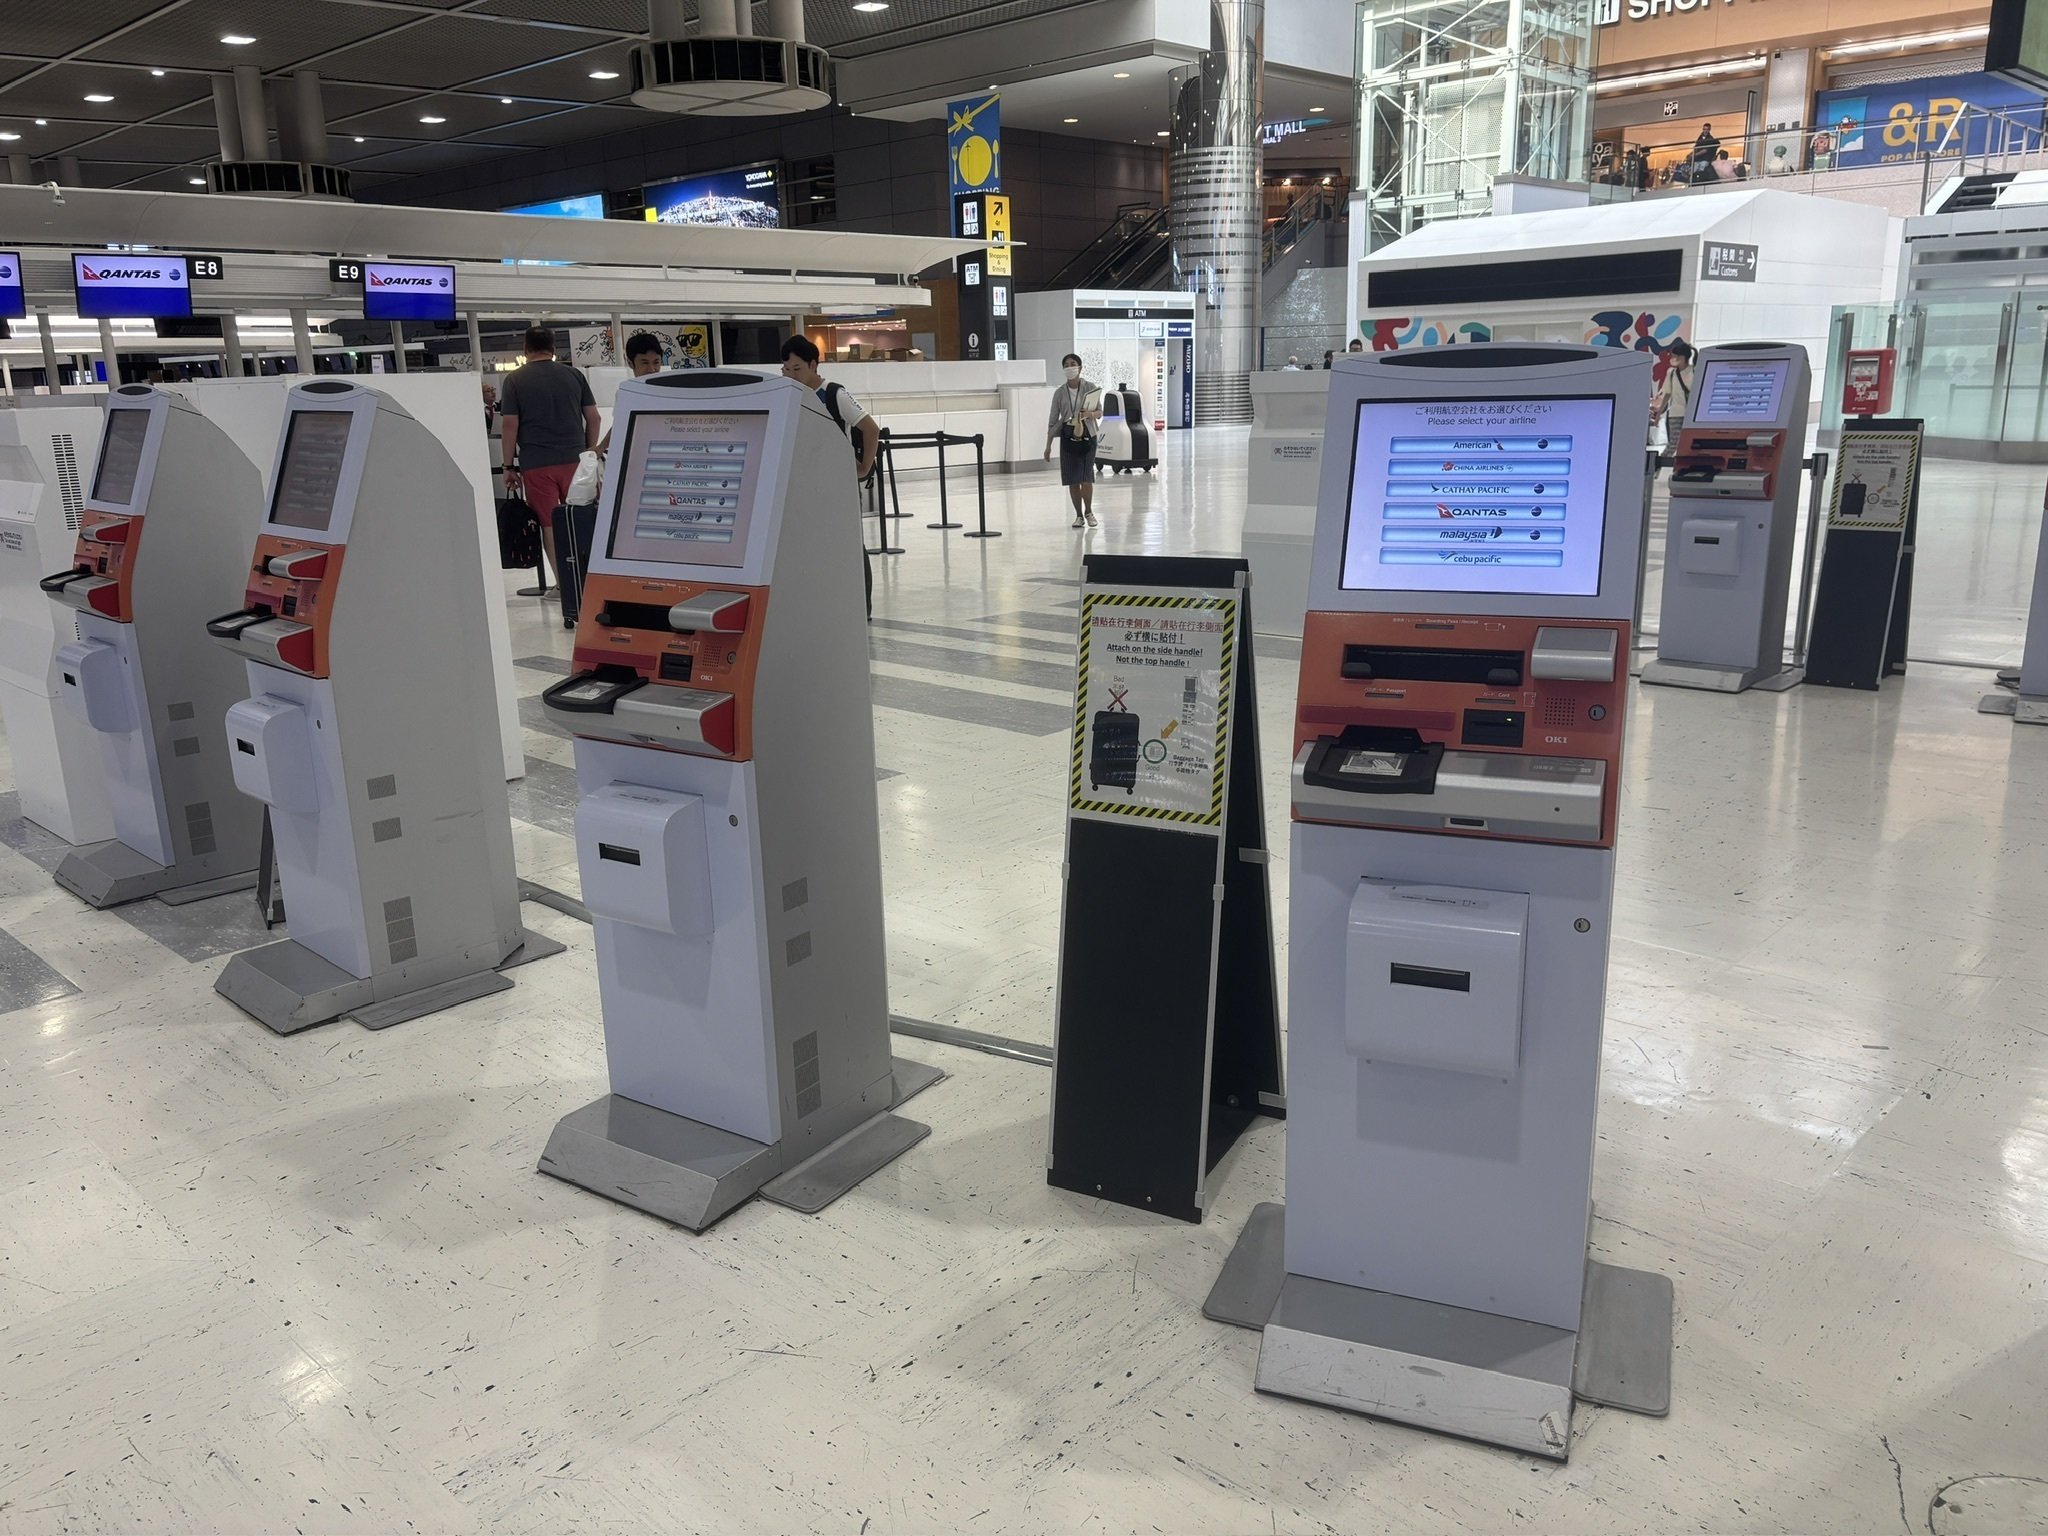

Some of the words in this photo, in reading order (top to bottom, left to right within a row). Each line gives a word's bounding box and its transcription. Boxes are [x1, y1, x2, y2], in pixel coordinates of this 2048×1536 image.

[1274, 120, 1306, 137] MALL
[1880, 153, 1903, 163] POP
[989, 252, 1009, 261] Shopping
[195, 260, 218, 276] E8
[338, 265, 359, 279] E9
[966, 265, 979, 273] ATM
[992, 265, 1006, 274] Dining
[1720, 265, 1739, 277] Customs
[99, 269, 161, 279] QANTAS
[383, 276, 433, 286] QANTAS
[1134, 309, 1147, 317] ATM
[1415, 404, 1552, 416] ご利用航空会社をお選びください
[1428, 417, 1456, 425] Please
[1458, 416, 1484, 425] select
[1486, 418, 1506, 427] your
[1509, 416, 1537, 425] airline
[1453, 440, 1492, 450] American
[1442, 486, 1477, 494] CATHAY
[1477, 486, 1510, 494] PACIFIC
[676, 496, 707, 505] QANTAS
[1452, 508, 1507, 517] QANTAS
[1439, 529, 1488, 541] malaysia
[1453, 555, 1473, 563] cebu
[1474, 554, 1502, 565] pacific
[1106, 643, 1130, 653] Attach
[1143, 645, 1155, 654] the
[1157, 646, 1173, 655] side
[1174, 646, 1203, 657] handle!
[1115, 655, 1130, 664] Not
[1131, 656, 1143, 665] the
[1145, 657, 1158, 667] top
[1159, 658, 1185, 668] handle
[1544, 735, 1568, 744] OKI
[1145, 764, 1161, 772] Good
